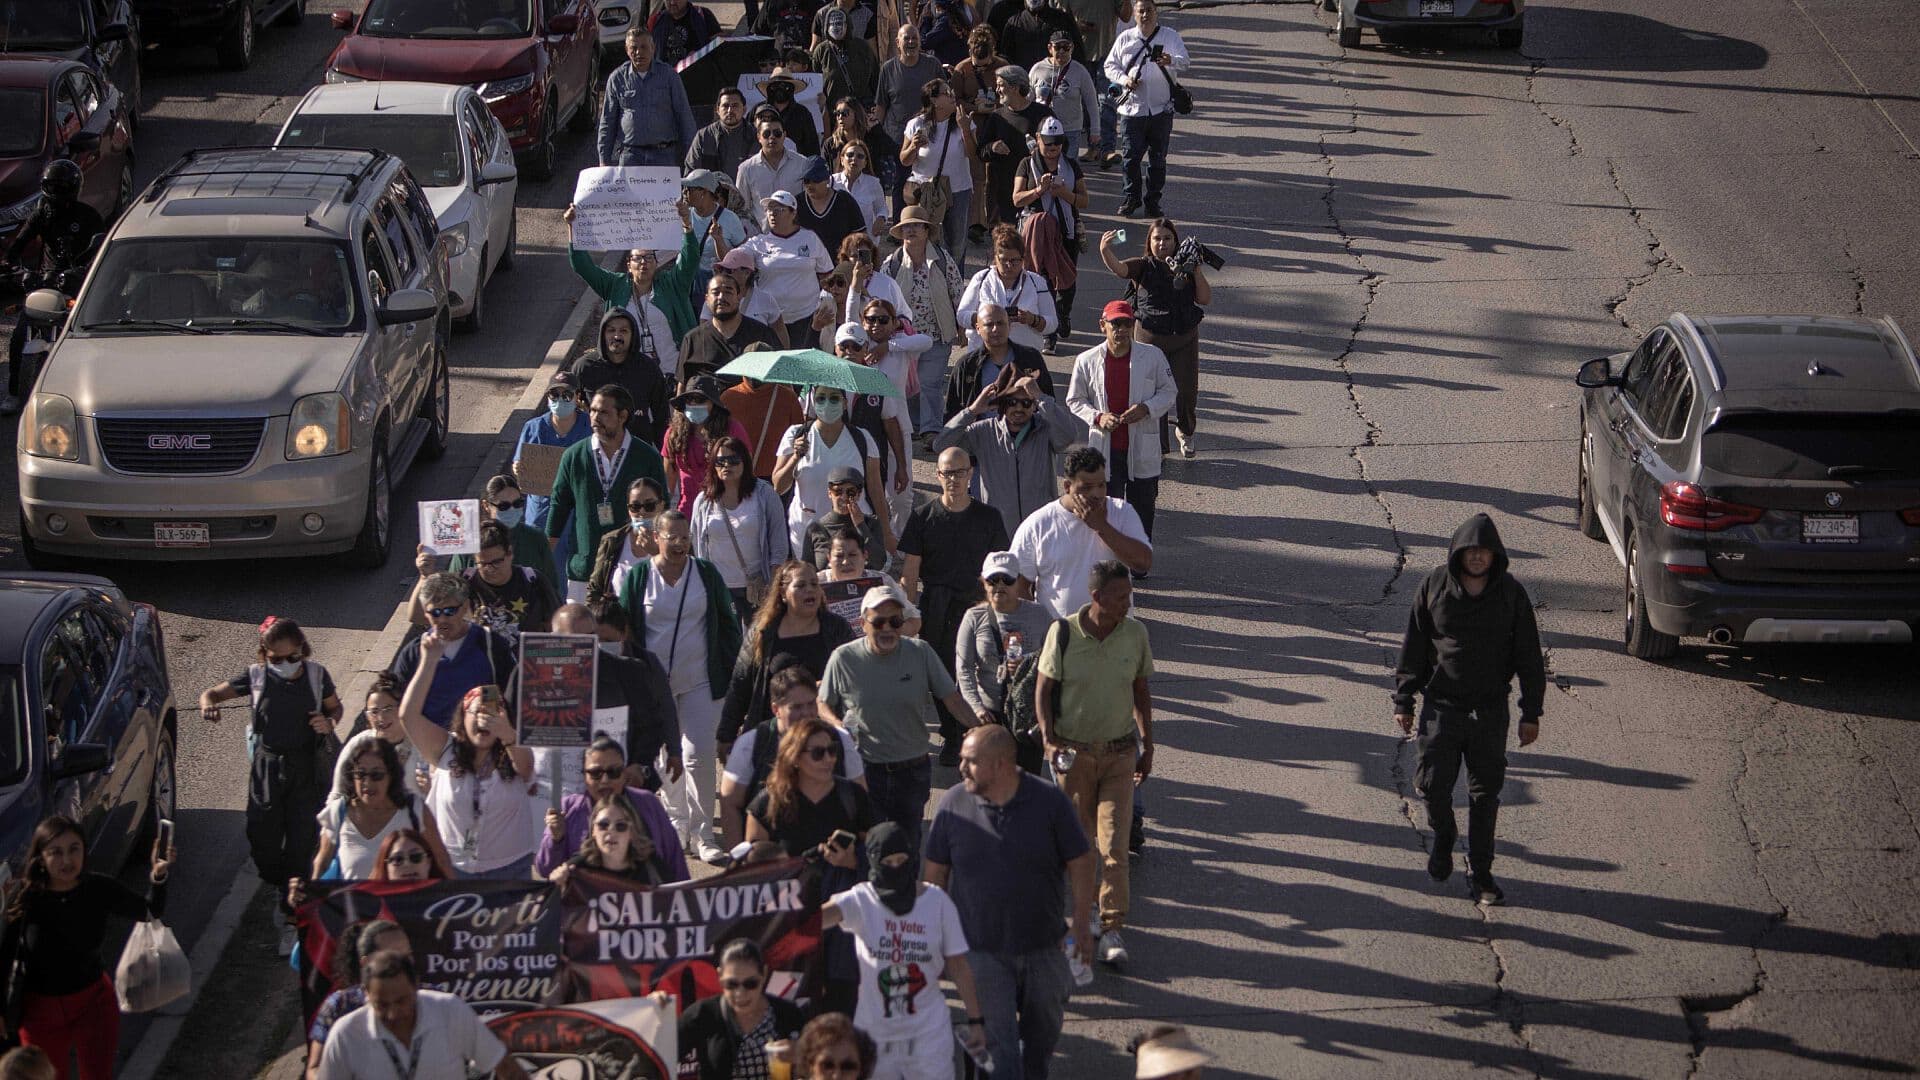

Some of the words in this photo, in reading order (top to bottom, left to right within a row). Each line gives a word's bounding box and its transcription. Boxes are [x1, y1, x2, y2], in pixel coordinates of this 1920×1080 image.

[662, 176, 673, 185] de
[148, 434, 211, 449] GMC
[156, 528, 208, 541] BLX-569-A
[1715, 551, 1745, 561] X3
[423, 893, 508, 940] Por
[515, 893, 549, 926] ti
[586, 891, 663, 933] ¡SAL
[668, 889, 693, 925] A
[692, 878, 805, 921] VOTAR
[884, 919, 897, 932] Yo
[452, 930, 498, 950] Por
[503, 926, 538, 949] mí
[597, 928, 674, 961] POR
[676, 924, 715, 957] EL
[426, 953, 470, 974] Por
[475, 951, 510, 971] los
[513, 952, 558, 975] que
[426, 972, 560, 1000] vienen
